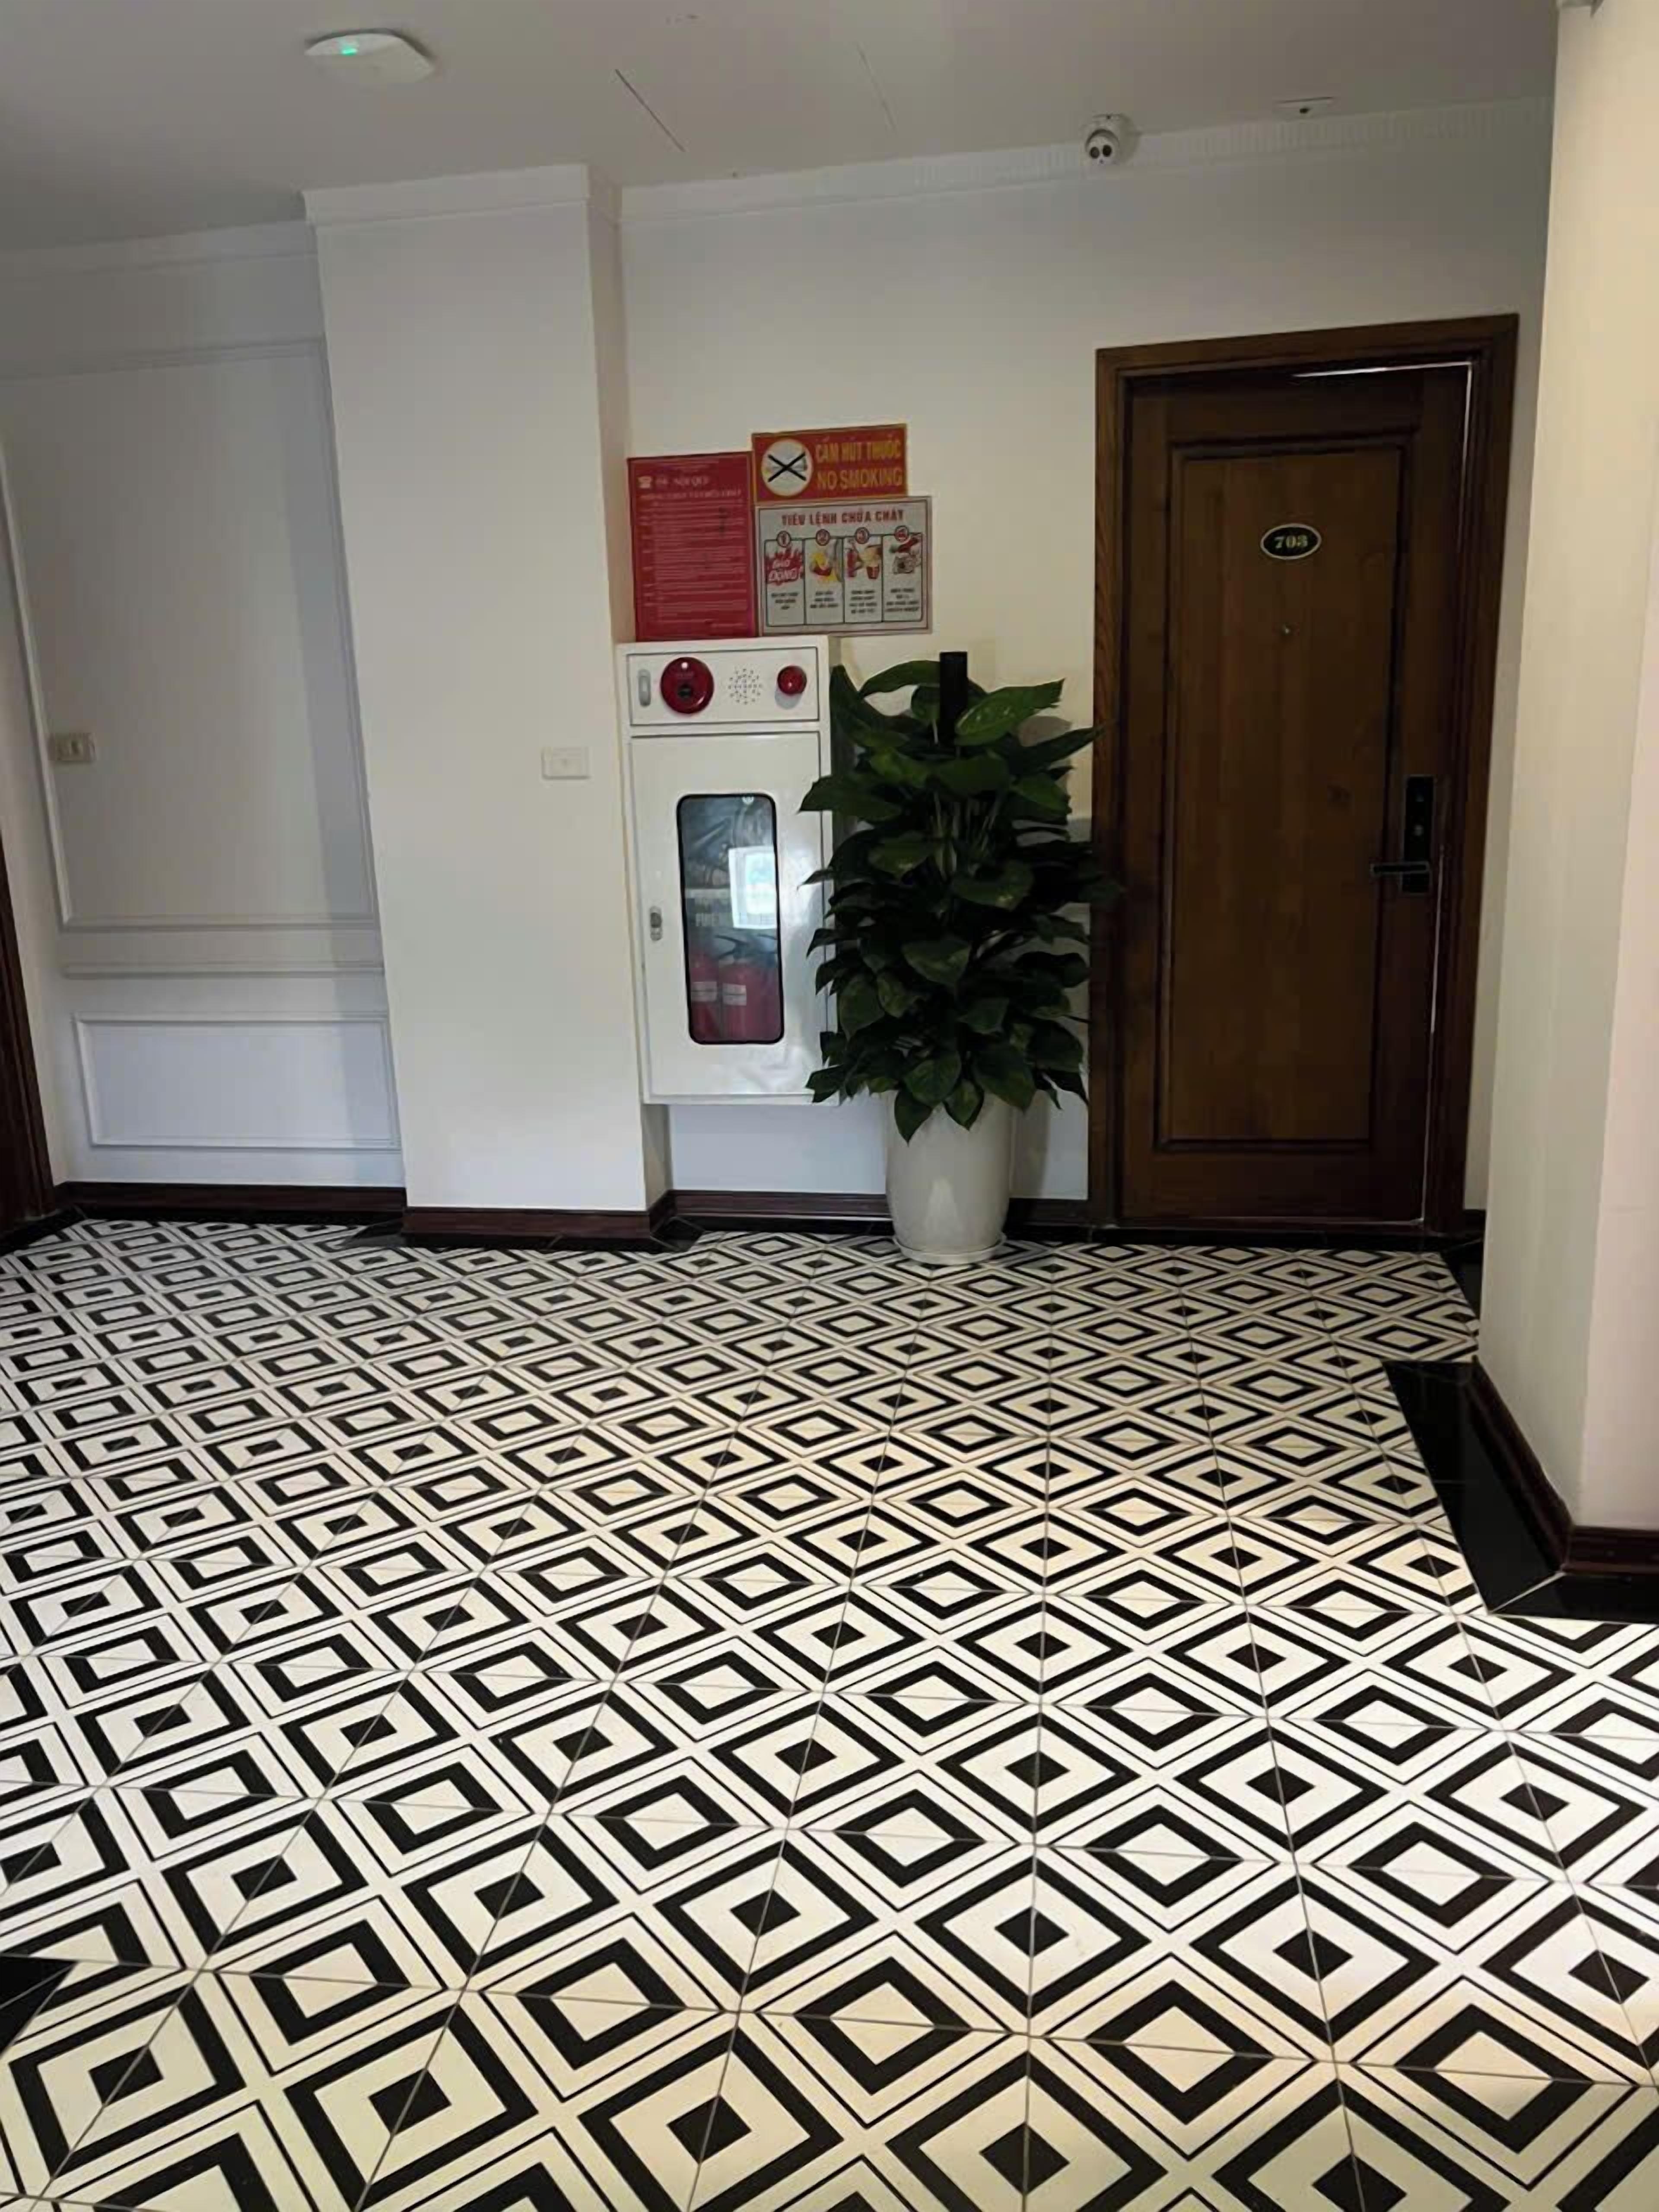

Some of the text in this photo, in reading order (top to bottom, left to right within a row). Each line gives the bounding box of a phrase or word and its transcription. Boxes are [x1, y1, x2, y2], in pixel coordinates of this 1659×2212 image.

[816, 433, 901, 463] CẤM HÚT THUỐC
[817, 467, 903, 490] NO SMOKING
